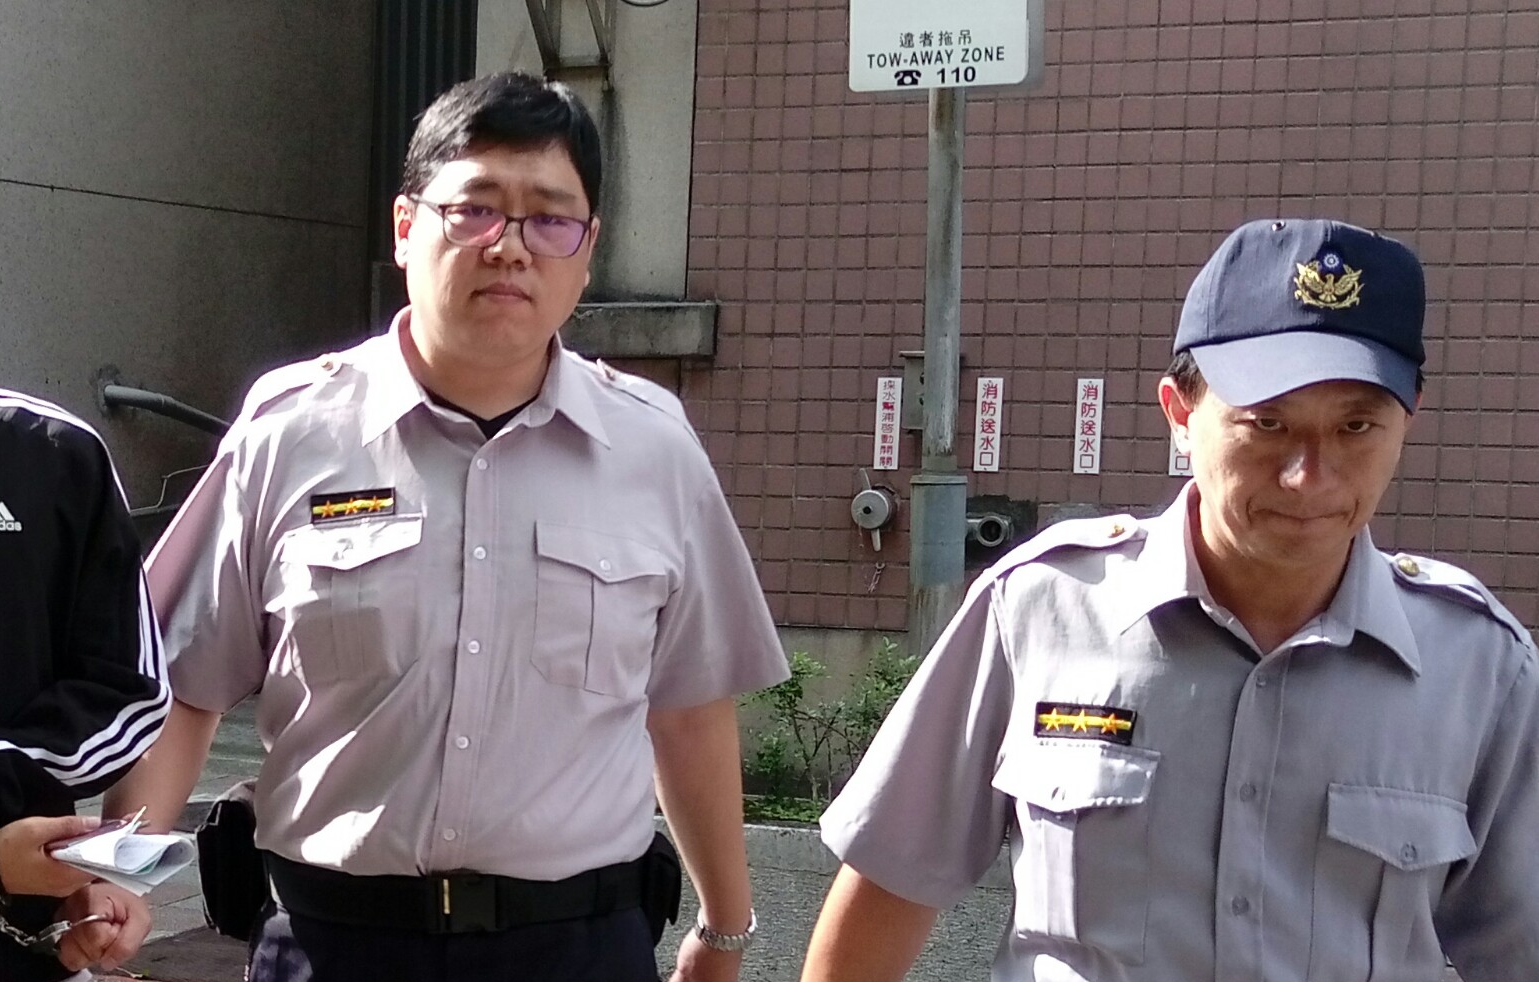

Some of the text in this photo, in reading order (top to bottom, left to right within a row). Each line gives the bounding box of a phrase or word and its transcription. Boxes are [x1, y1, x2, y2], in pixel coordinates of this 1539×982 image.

[899, 29, 972, 48] 違者拖吊
[867, 46, 1005, 69] TOW-AWAY ZONE
[936, 66, 976, 84] 110
[979, 383, 999, 467] 消防送水口
[1079, 384, 1099, 469] 消防送水口
